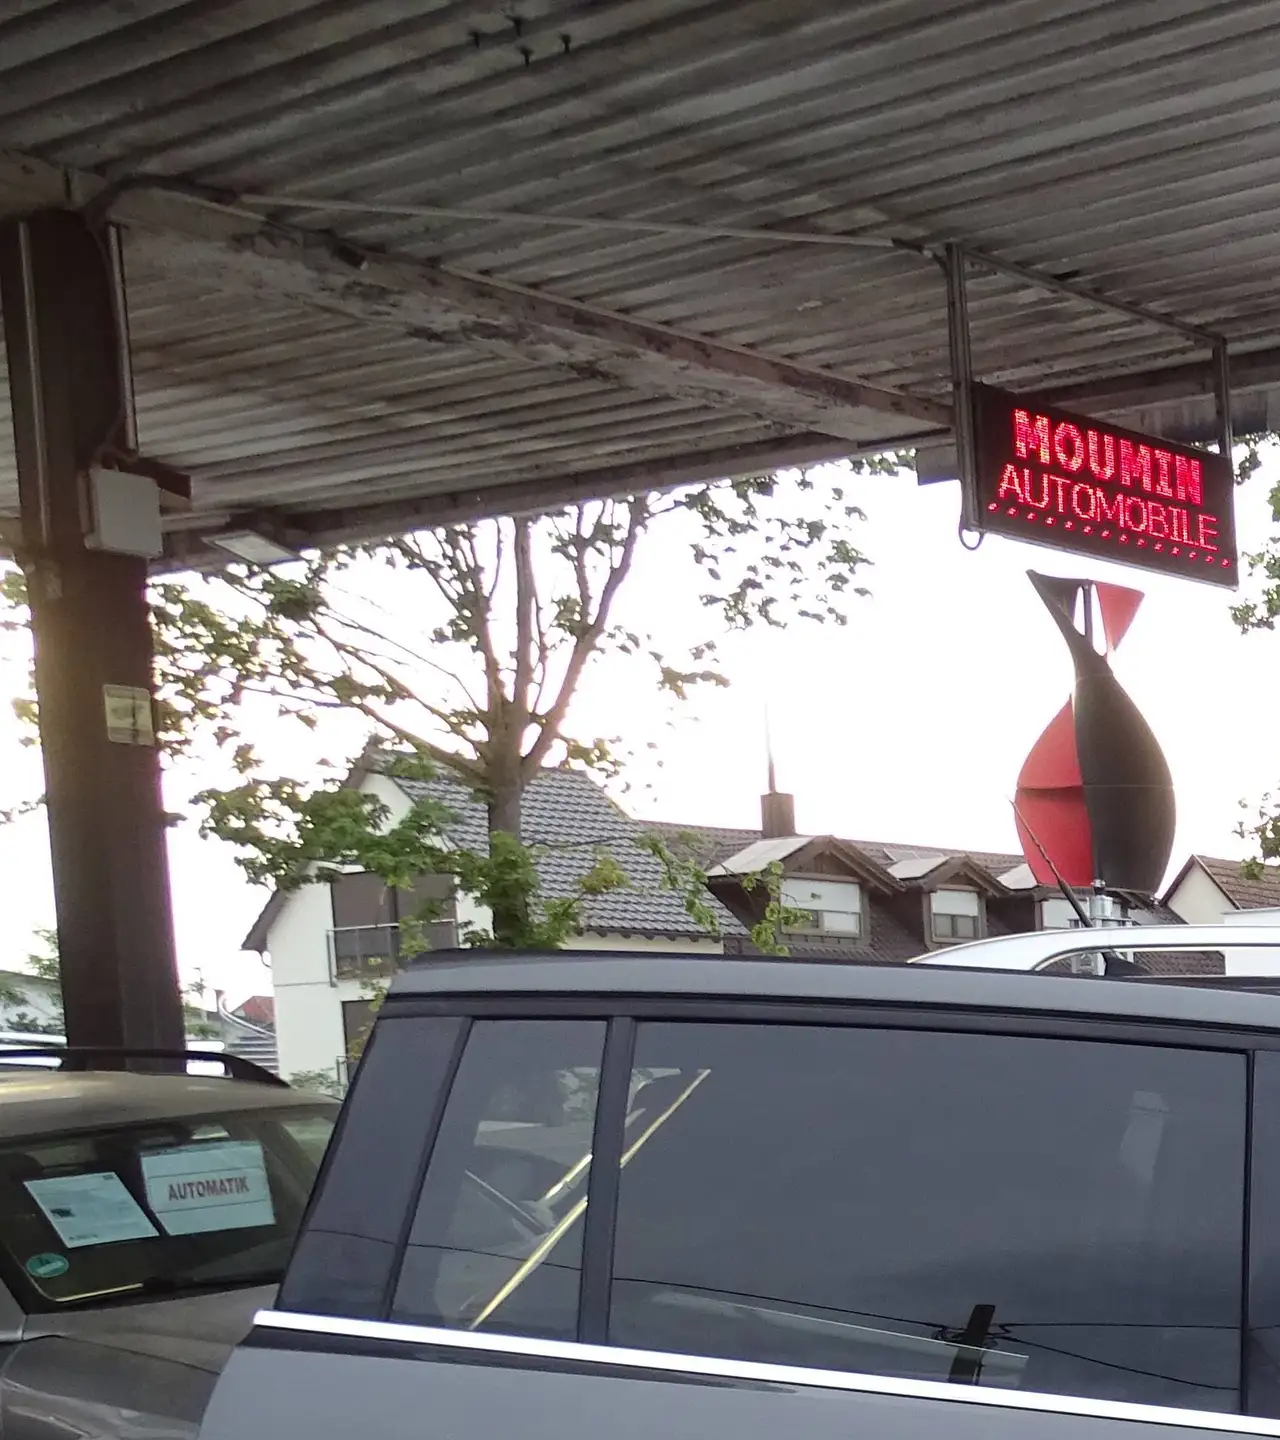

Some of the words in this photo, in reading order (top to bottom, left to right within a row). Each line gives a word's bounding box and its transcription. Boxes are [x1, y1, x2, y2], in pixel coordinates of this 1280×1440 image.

[1014, 409, 1203, 505] MOUMIN
[998, 463, 1219, 551] AUTOMOBILE
[168, 1175, 250, 1202] AUTOMATIK
